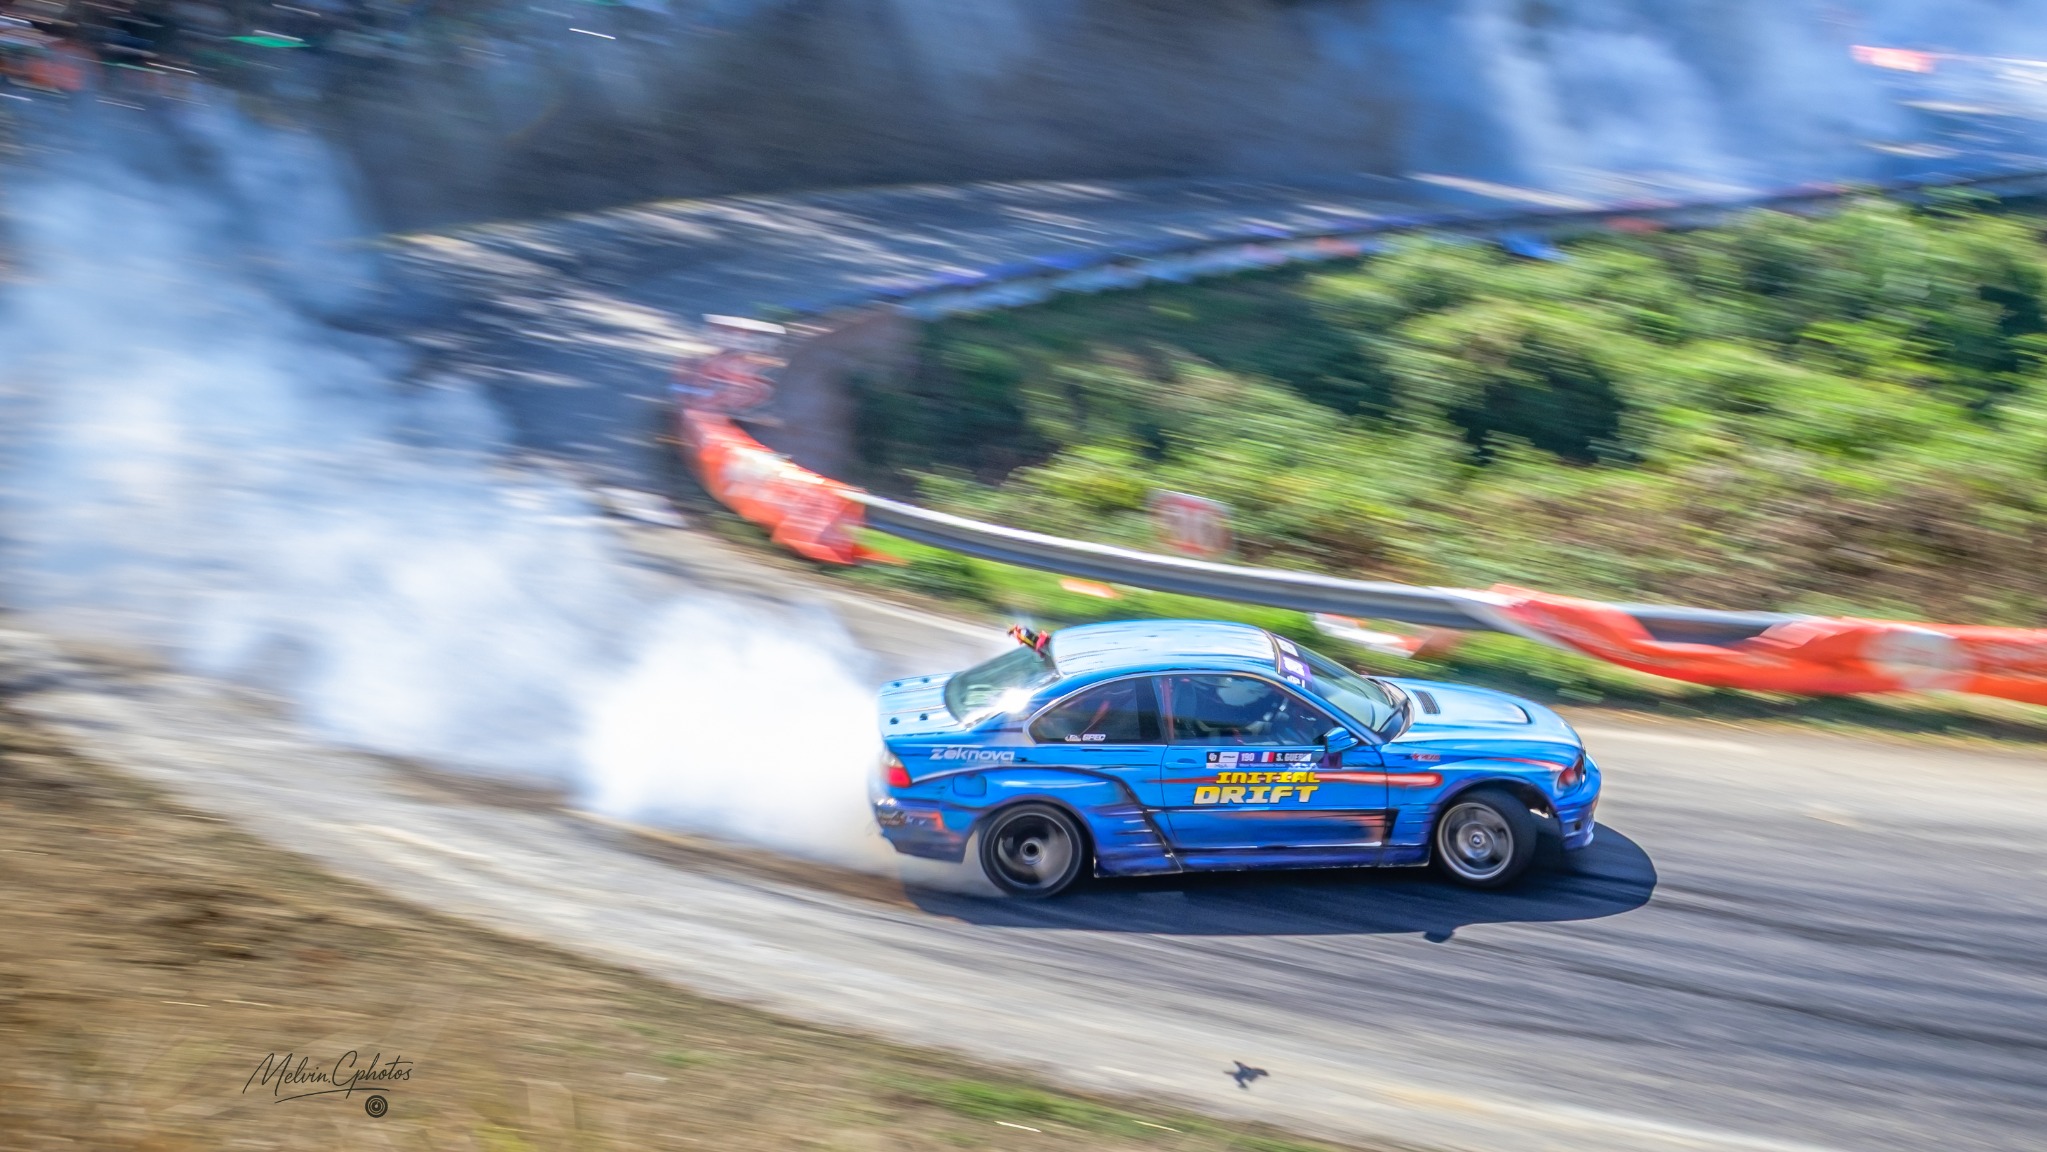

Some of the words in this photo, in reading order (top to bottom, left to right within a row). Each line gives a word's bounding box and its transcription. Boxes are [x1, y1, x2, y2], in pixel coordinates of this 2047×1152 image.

[1241, 752, 1255, 762] 190
[1216, 772, 1320, 784] INITIAL
[1193, 786, 1319, 805] DRIFT
